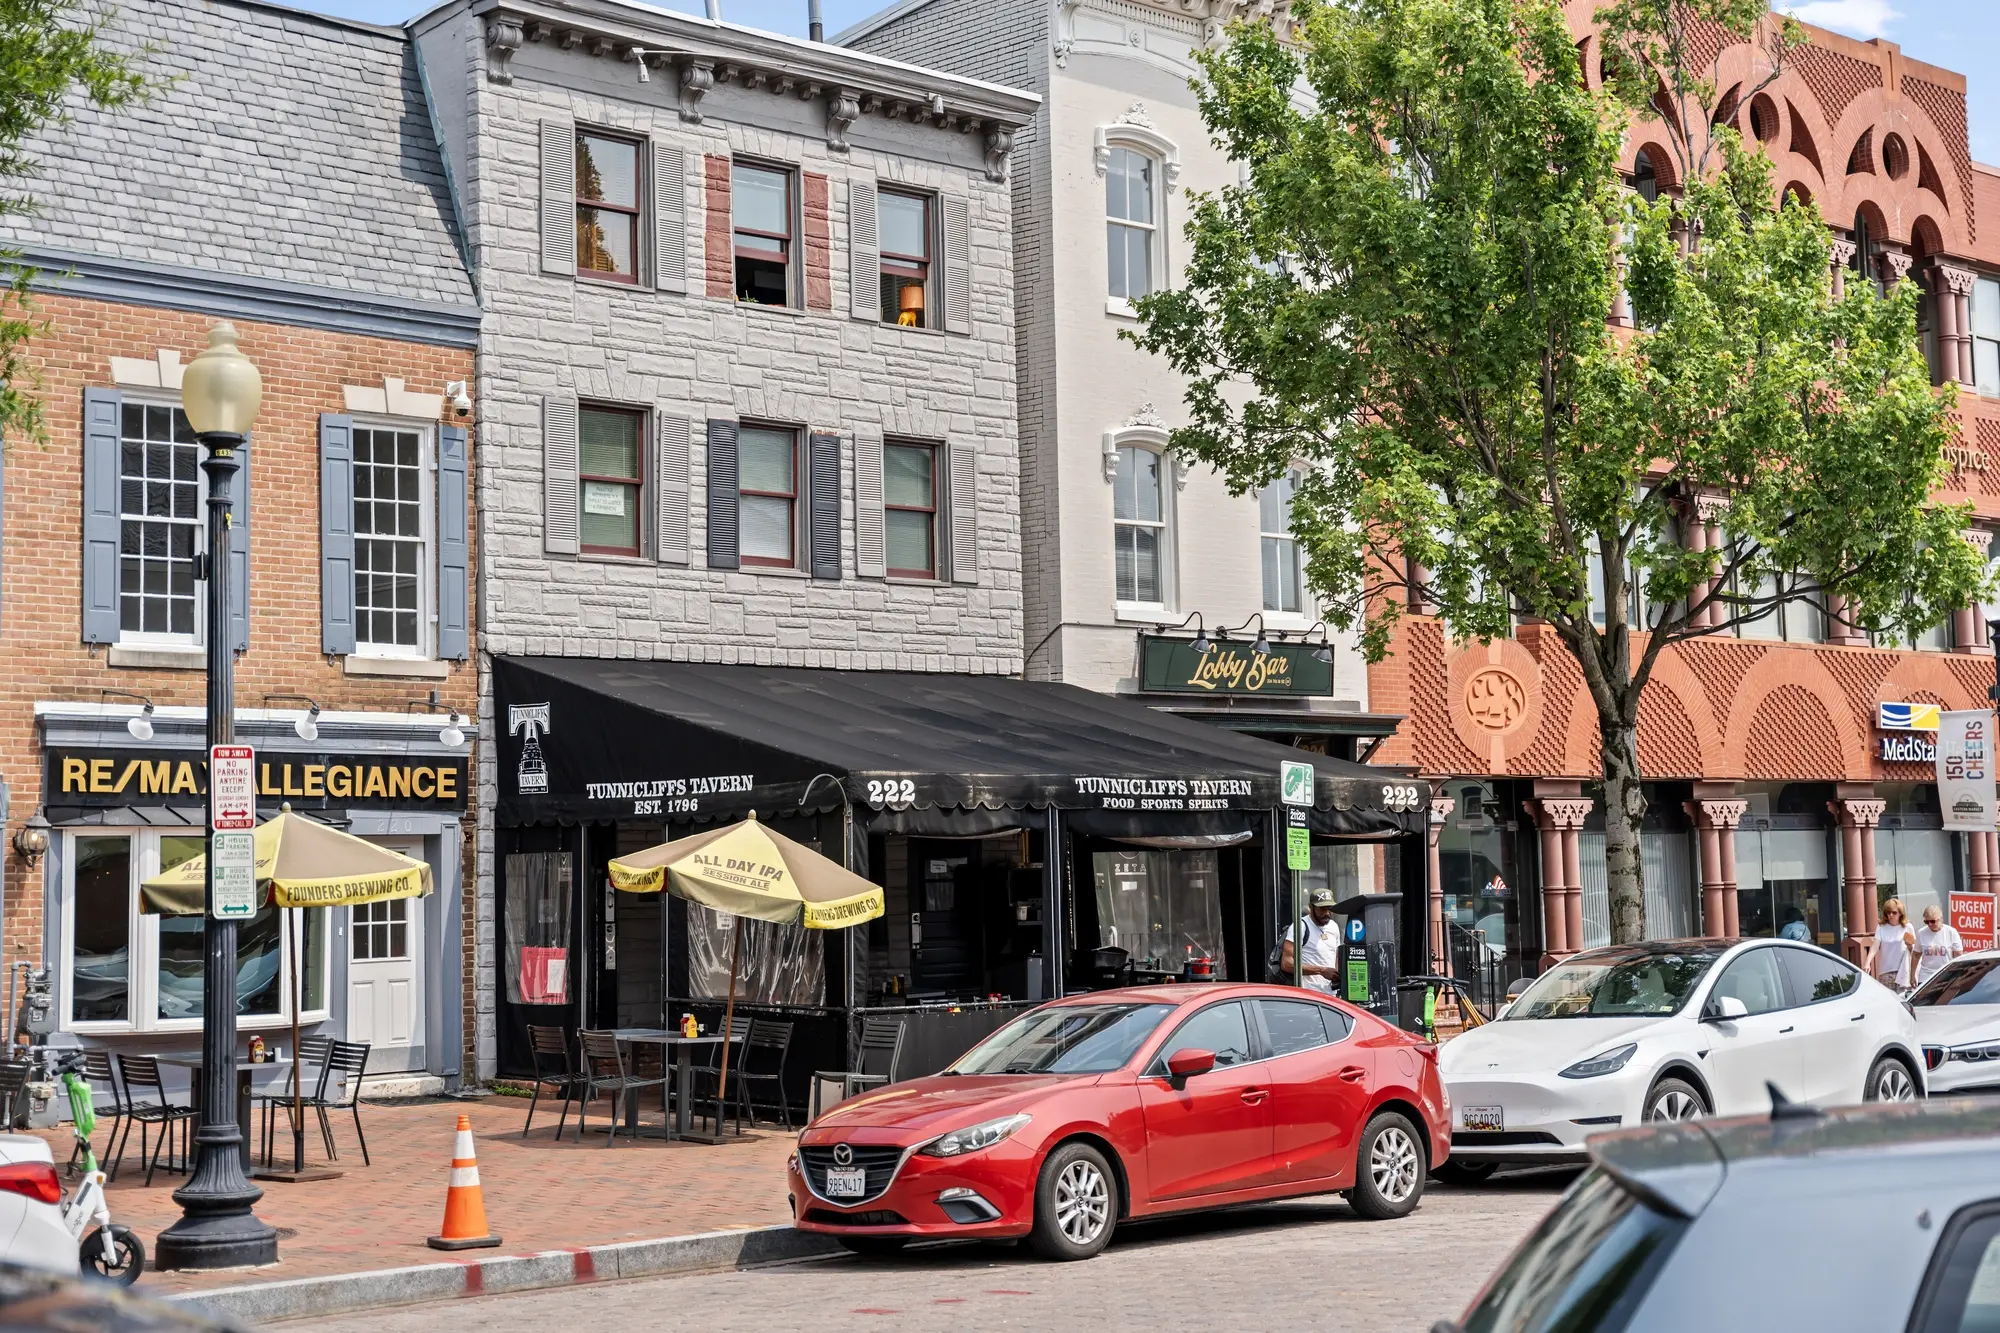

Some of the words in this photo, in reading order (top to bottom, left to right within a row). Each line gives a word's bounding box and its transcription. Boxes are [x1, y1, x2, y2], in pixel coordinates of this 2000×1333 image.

[1188, 643, 1247, 689] Lobby
[1246, 650, 1288, 690] Bar
[217, 749, 230, 757] TOW
[1883, 736, 1937, 762] MedSta
[1965, 721, 1985, 780] CHEERS
[217, 768, 248, 776] PARKING
[1305, 768, 1311, 780] 2
[1945, 756, 1964, 780] 150
[254, 762, 457, 798] LLEGIANCE
[521, 776, 544, 785] TAVERN
[586, 779, 687, 799] TUNNICLIFFS
[690, 775, 754, 794] TAVERN
[1075, 777, 1188, 796] TUNNICLIFFS
[1190, 780, 1252, 796] TAVERN
[867, 780, 916, 803] 222
[1382, 785, 1419, 806] 222
[634, 800, 662, 814] EST.
[667, 799, 698, 813] 1796
[1102, 797, 1135, 809] FOOD
[1141, 798, 1183, 809] SPORTS
[1188, 799, 1229, 809] SPIRITS
[377, 820, 411, 832] 220
[216, 836, 224, 848] 2
[181, 861, 206, 872] AL
[694, 854, 722, 868] ALL
[726, 858, 757, 873] DAY
[760, 864, 783, 882] IPA
[702, 867, 747, 884] SESSION
[749, 878, 770, 889] ALE
[287, 884, 343, 902] FOUNDERS
[345, 879, 393, 898] BREWING
[395, 876, 413, 892] CO.
[834, 901, 867, 919] BREWING
[1951, 899, 1993, 914] URGENT
[1351, 919, 1363, 940] P
[1958, 915, 1986, 929] CARE
[1982, 940, 1993, 949] DE
[828, 1178, 862, 1192] 9BEN417
